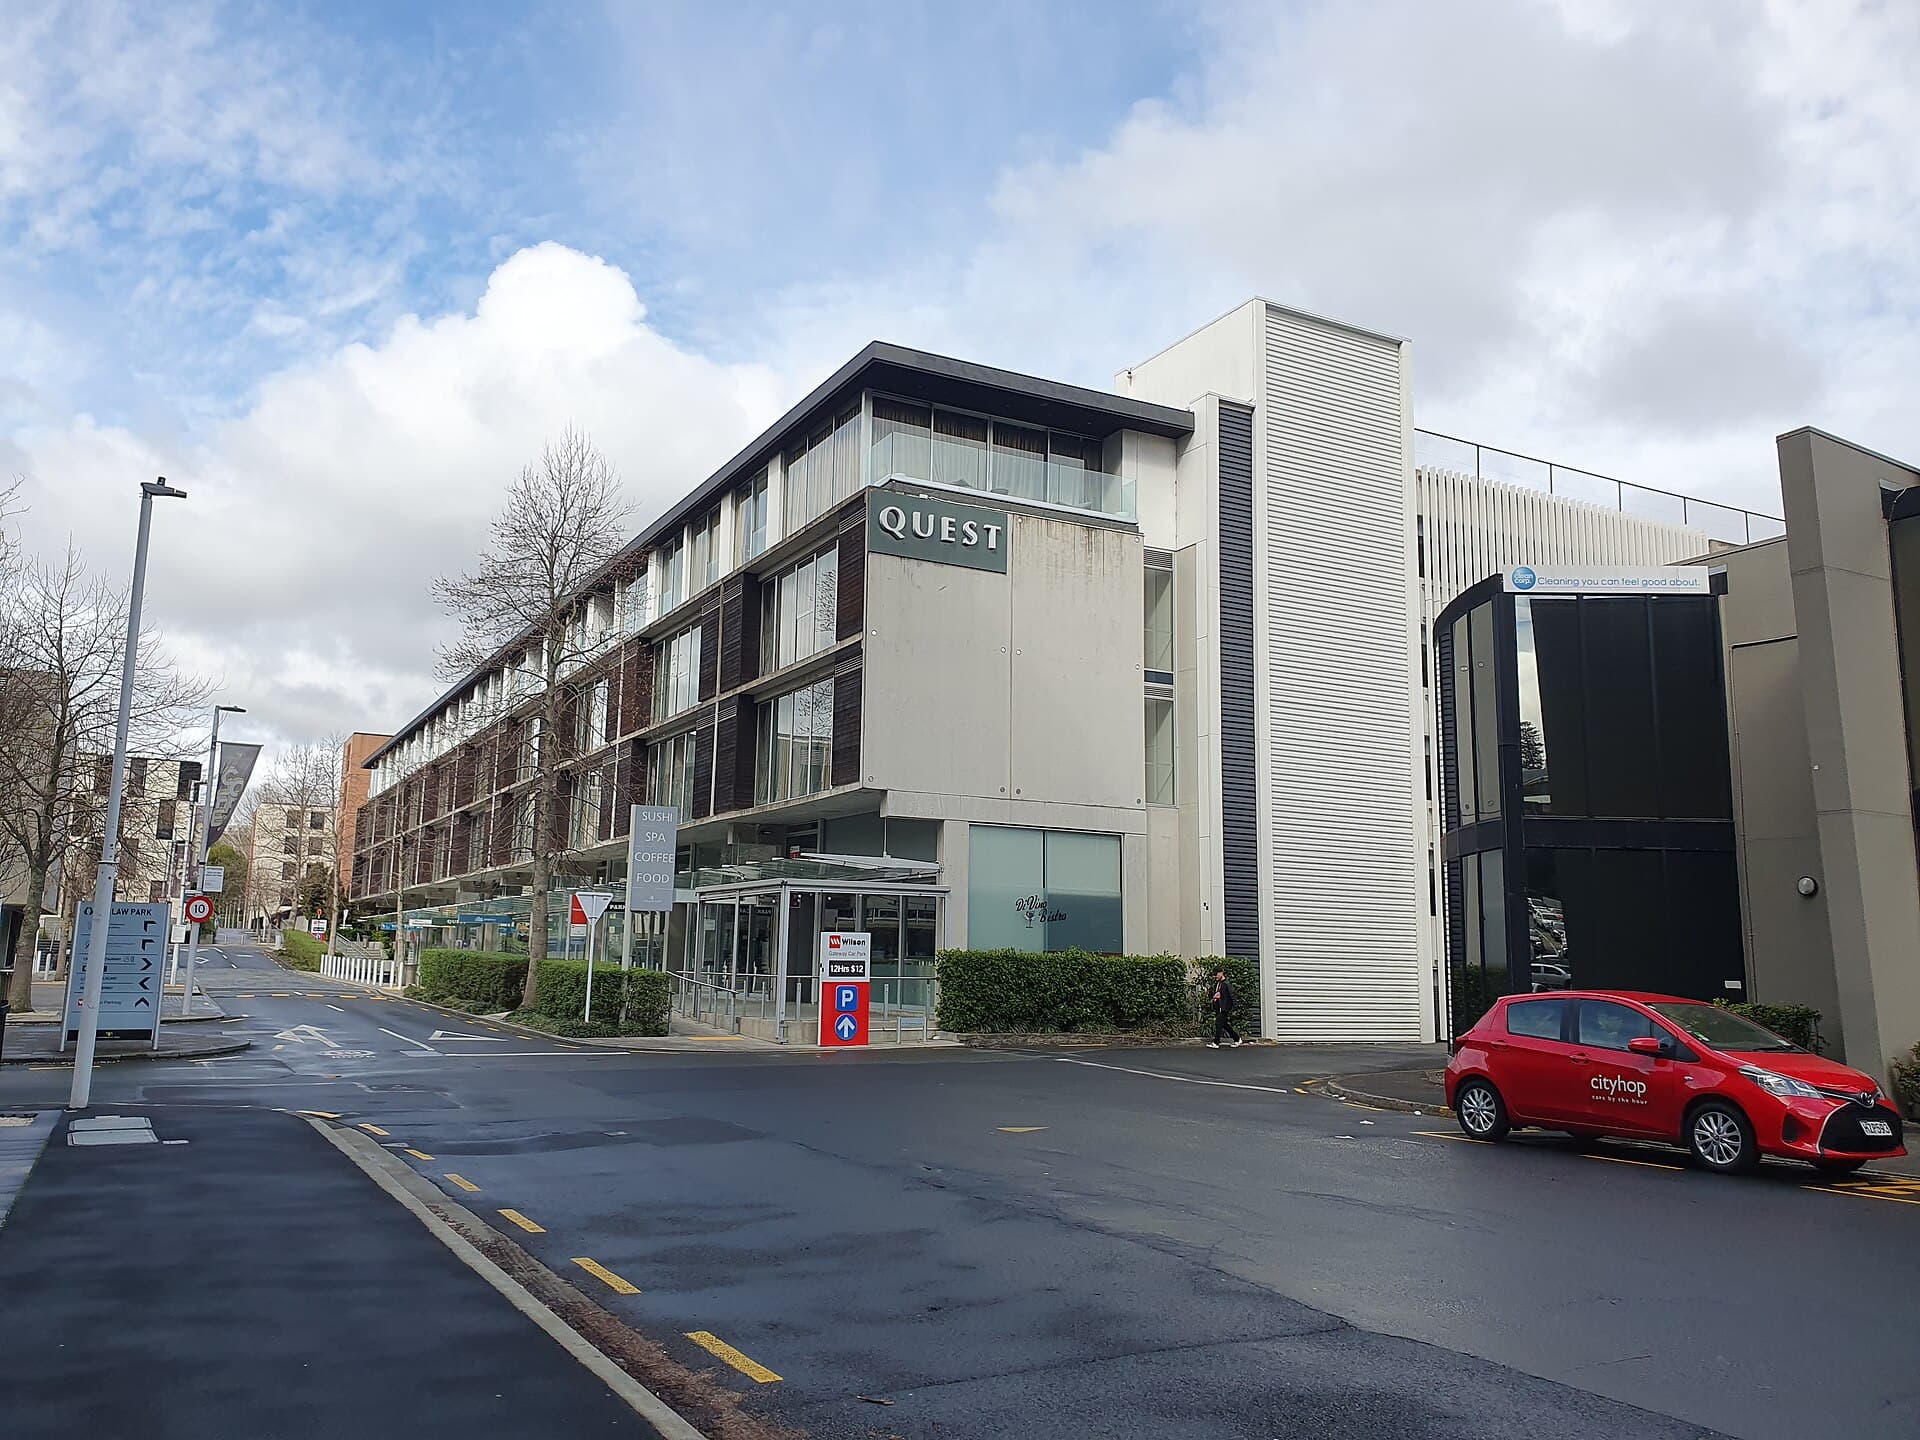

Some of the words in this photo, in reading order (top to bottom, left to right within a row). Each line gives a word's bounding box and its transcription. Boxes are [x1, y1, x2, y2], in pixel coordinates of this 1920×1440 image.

[879, 506, 1001, 550] QUEST
[1537, 577, 1580, 587] Cleaning
[1621, 577, 1639, 586] feel
[1641, 577, 1667, 588] good
[1669, 577, 1701, 586] about.
[642, 811, 673, 823] SUSHI
[645, 832, 666, 842] SPA
[634, 852, 675, 864] COFFEE
[636, 873, 670, 884] FOOD
[130, 908, 152, 916] PARK
[194, 904, 206, 914] 10
[842, 938, 866, 946] Wilson
[830, 964, 850, 973] 12Hrs
[850, 964, 864, 973] $12
[841, 989, 854, 1008] P
[1590, 1074, 1647, 1098] cityhop
